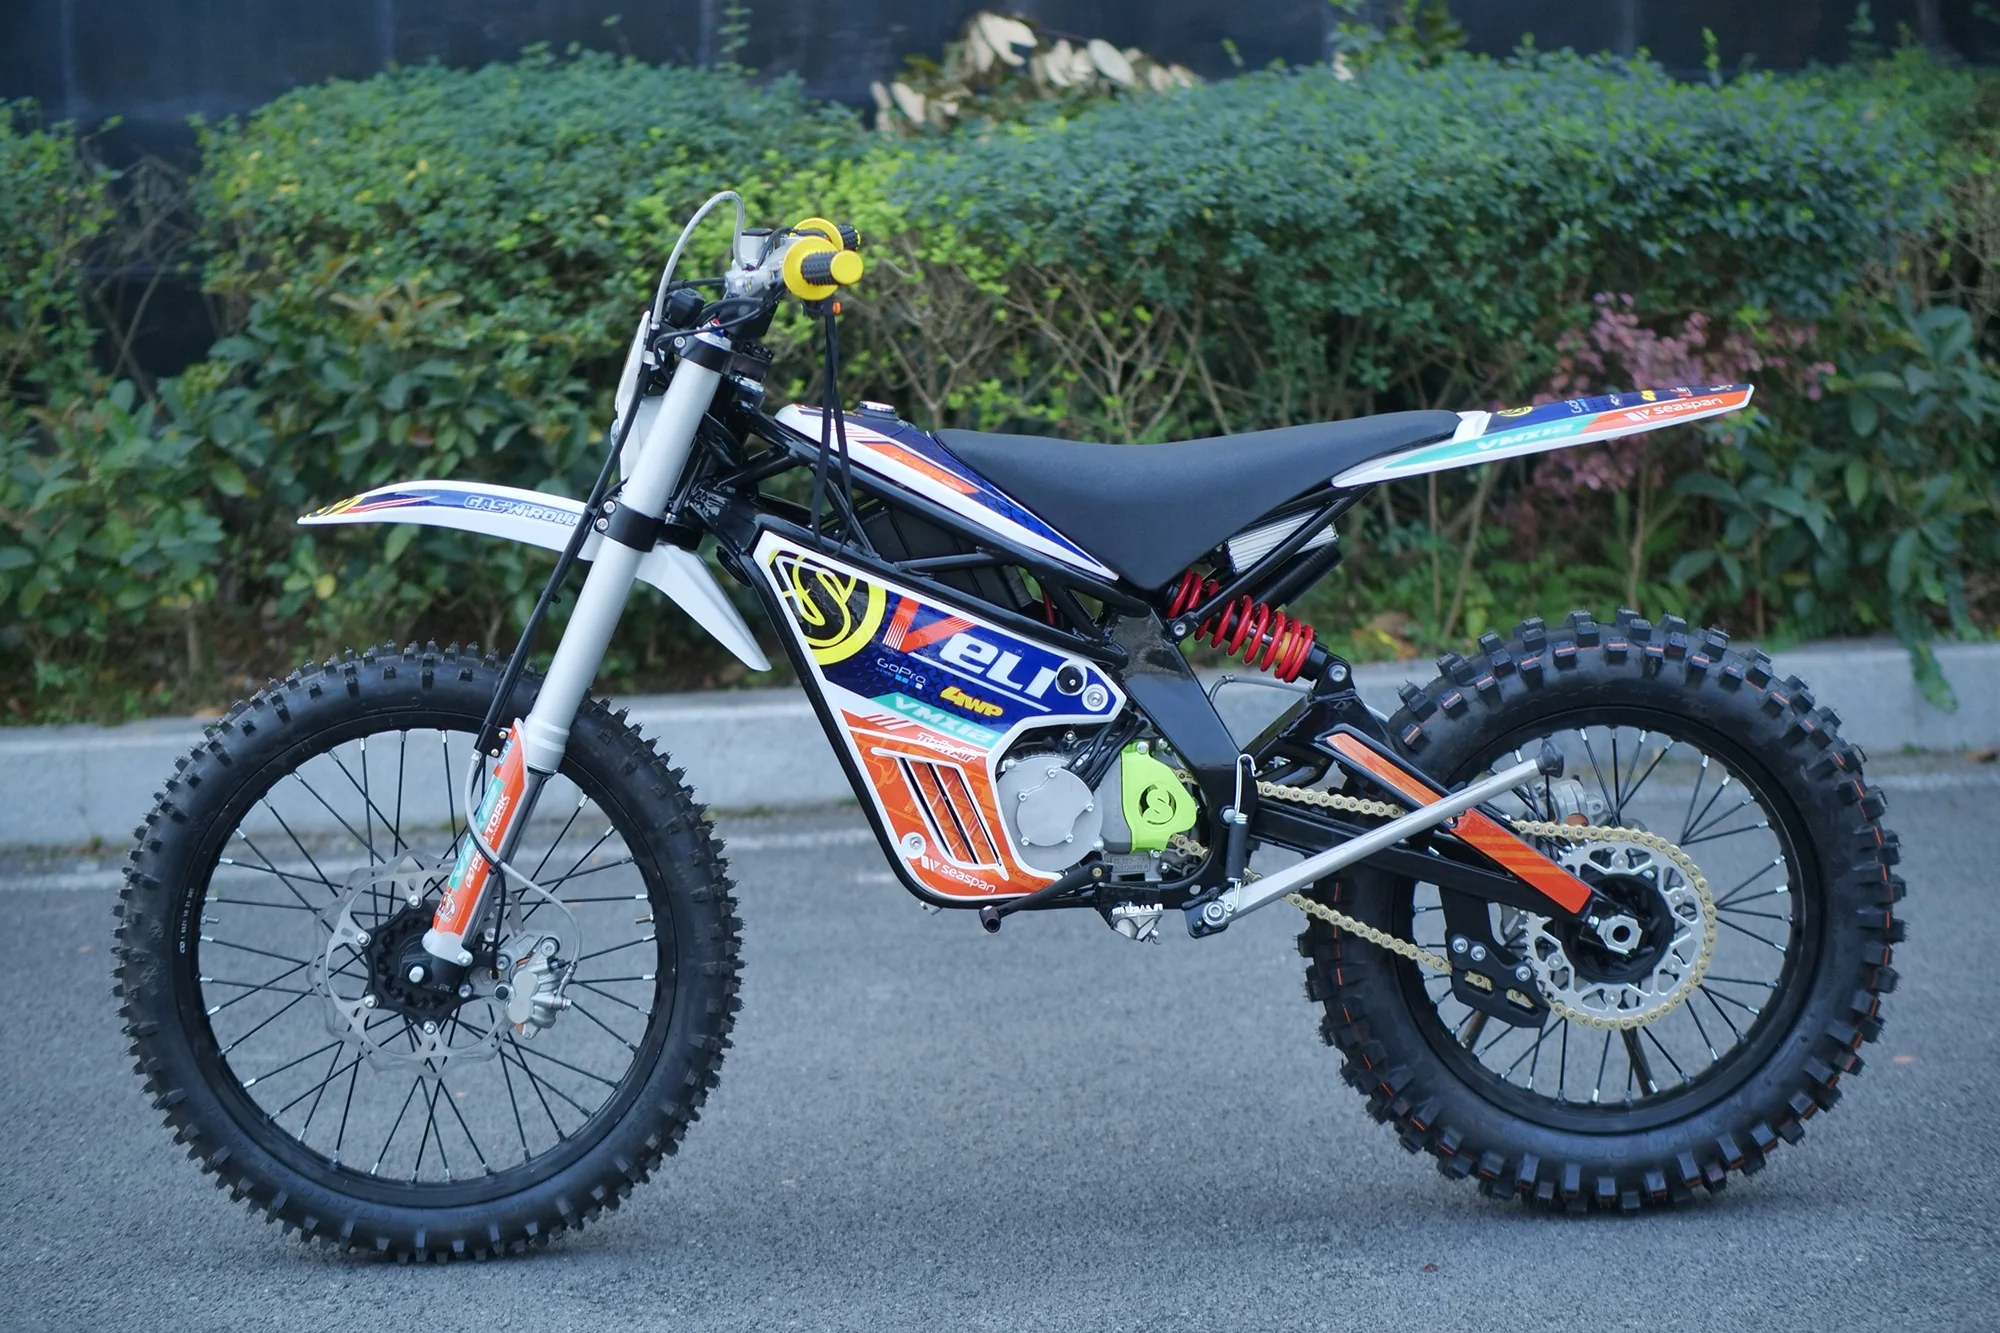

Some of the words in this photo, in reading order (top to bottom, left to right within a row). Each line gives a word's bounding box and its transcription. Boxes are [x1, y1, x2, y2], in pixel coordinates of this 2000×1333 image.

[1653, 397, 1723, 415] seaspan
[876, 657, 926, 684] GoPro
[895, 695, 995, 740] VMX12
[485, 792, 509, 834] TORK
[940, 864, 996, 893] seaspan
